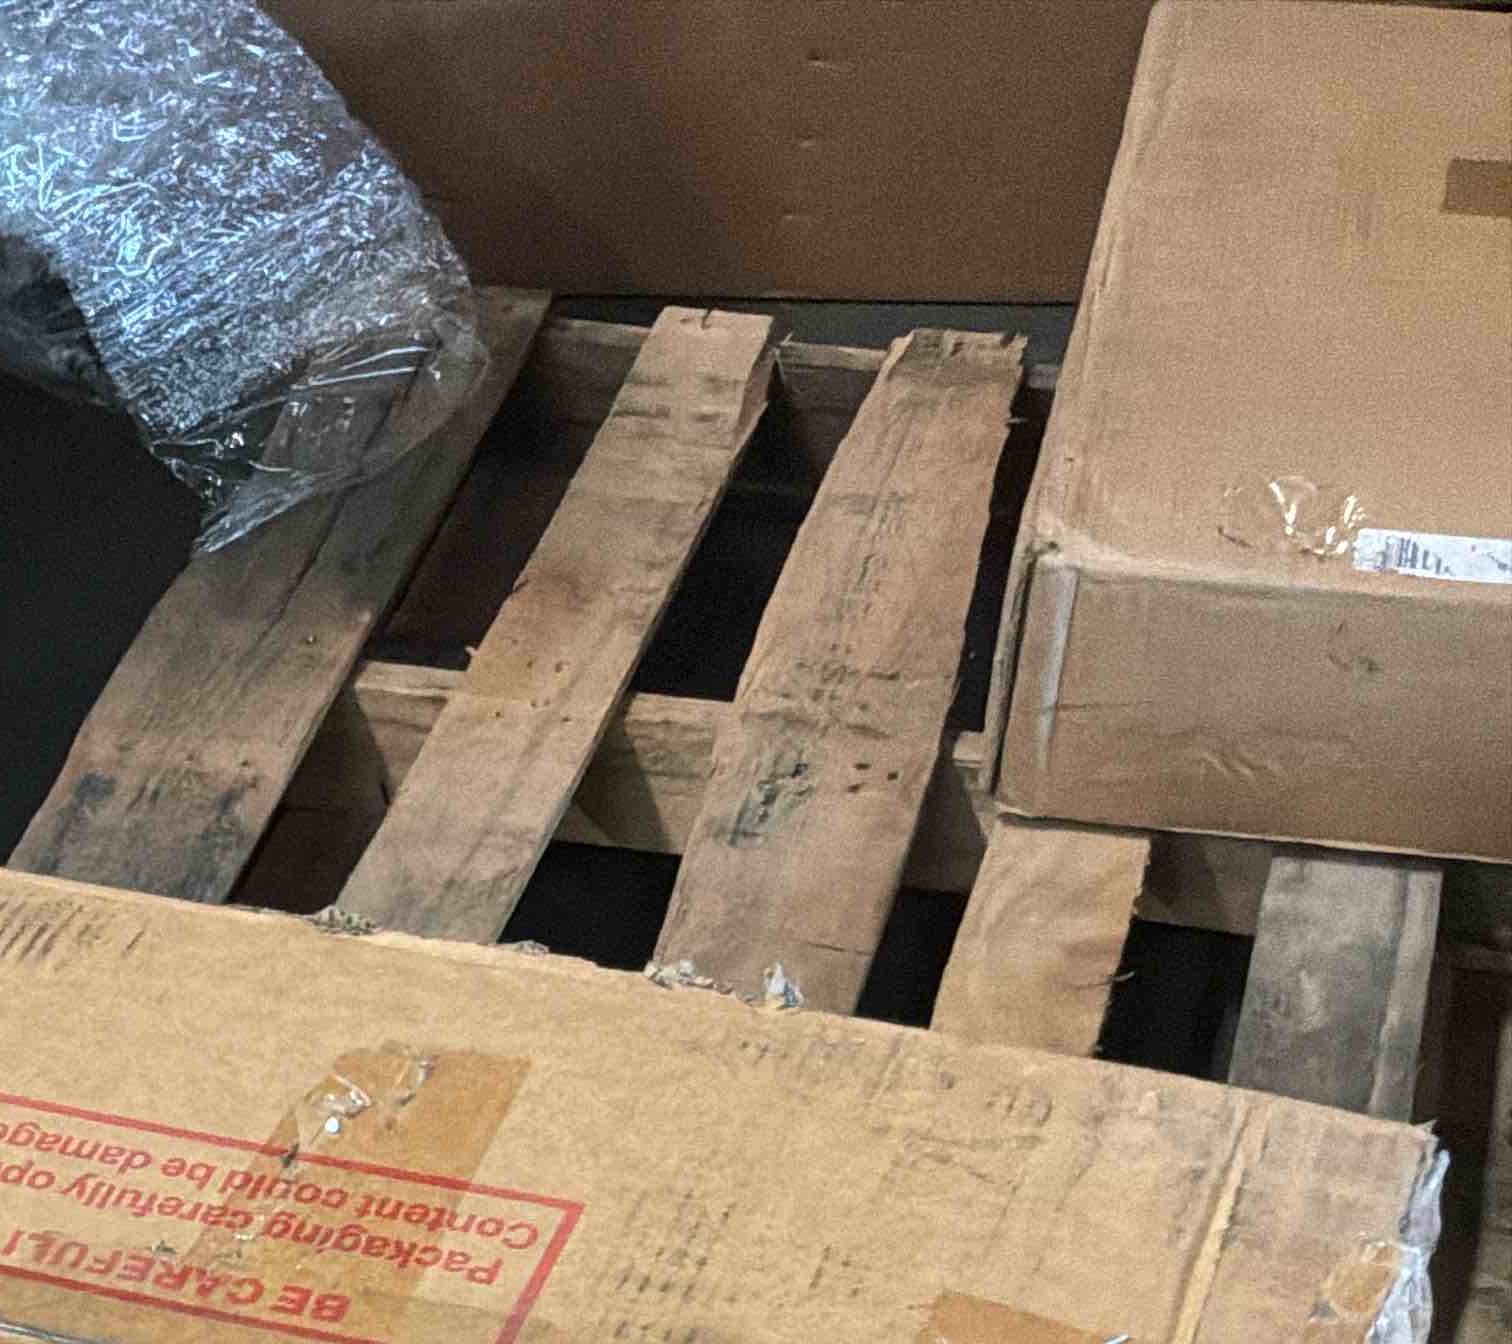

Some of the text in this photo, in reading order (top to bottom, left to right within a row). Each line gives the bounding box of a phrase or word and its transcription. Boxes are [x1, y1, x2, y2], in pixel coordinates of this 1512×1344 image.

[59, 1173, 256, 1230] carefully
[160, 1157, 216, 1191] be
[218, 1169, 349, 1210] could
[263, 1211, 503, 1285] Packaging
[354, 1194, 539, 1250] Content
[1, 1230, 352, 1322] BE CAREFUL!
